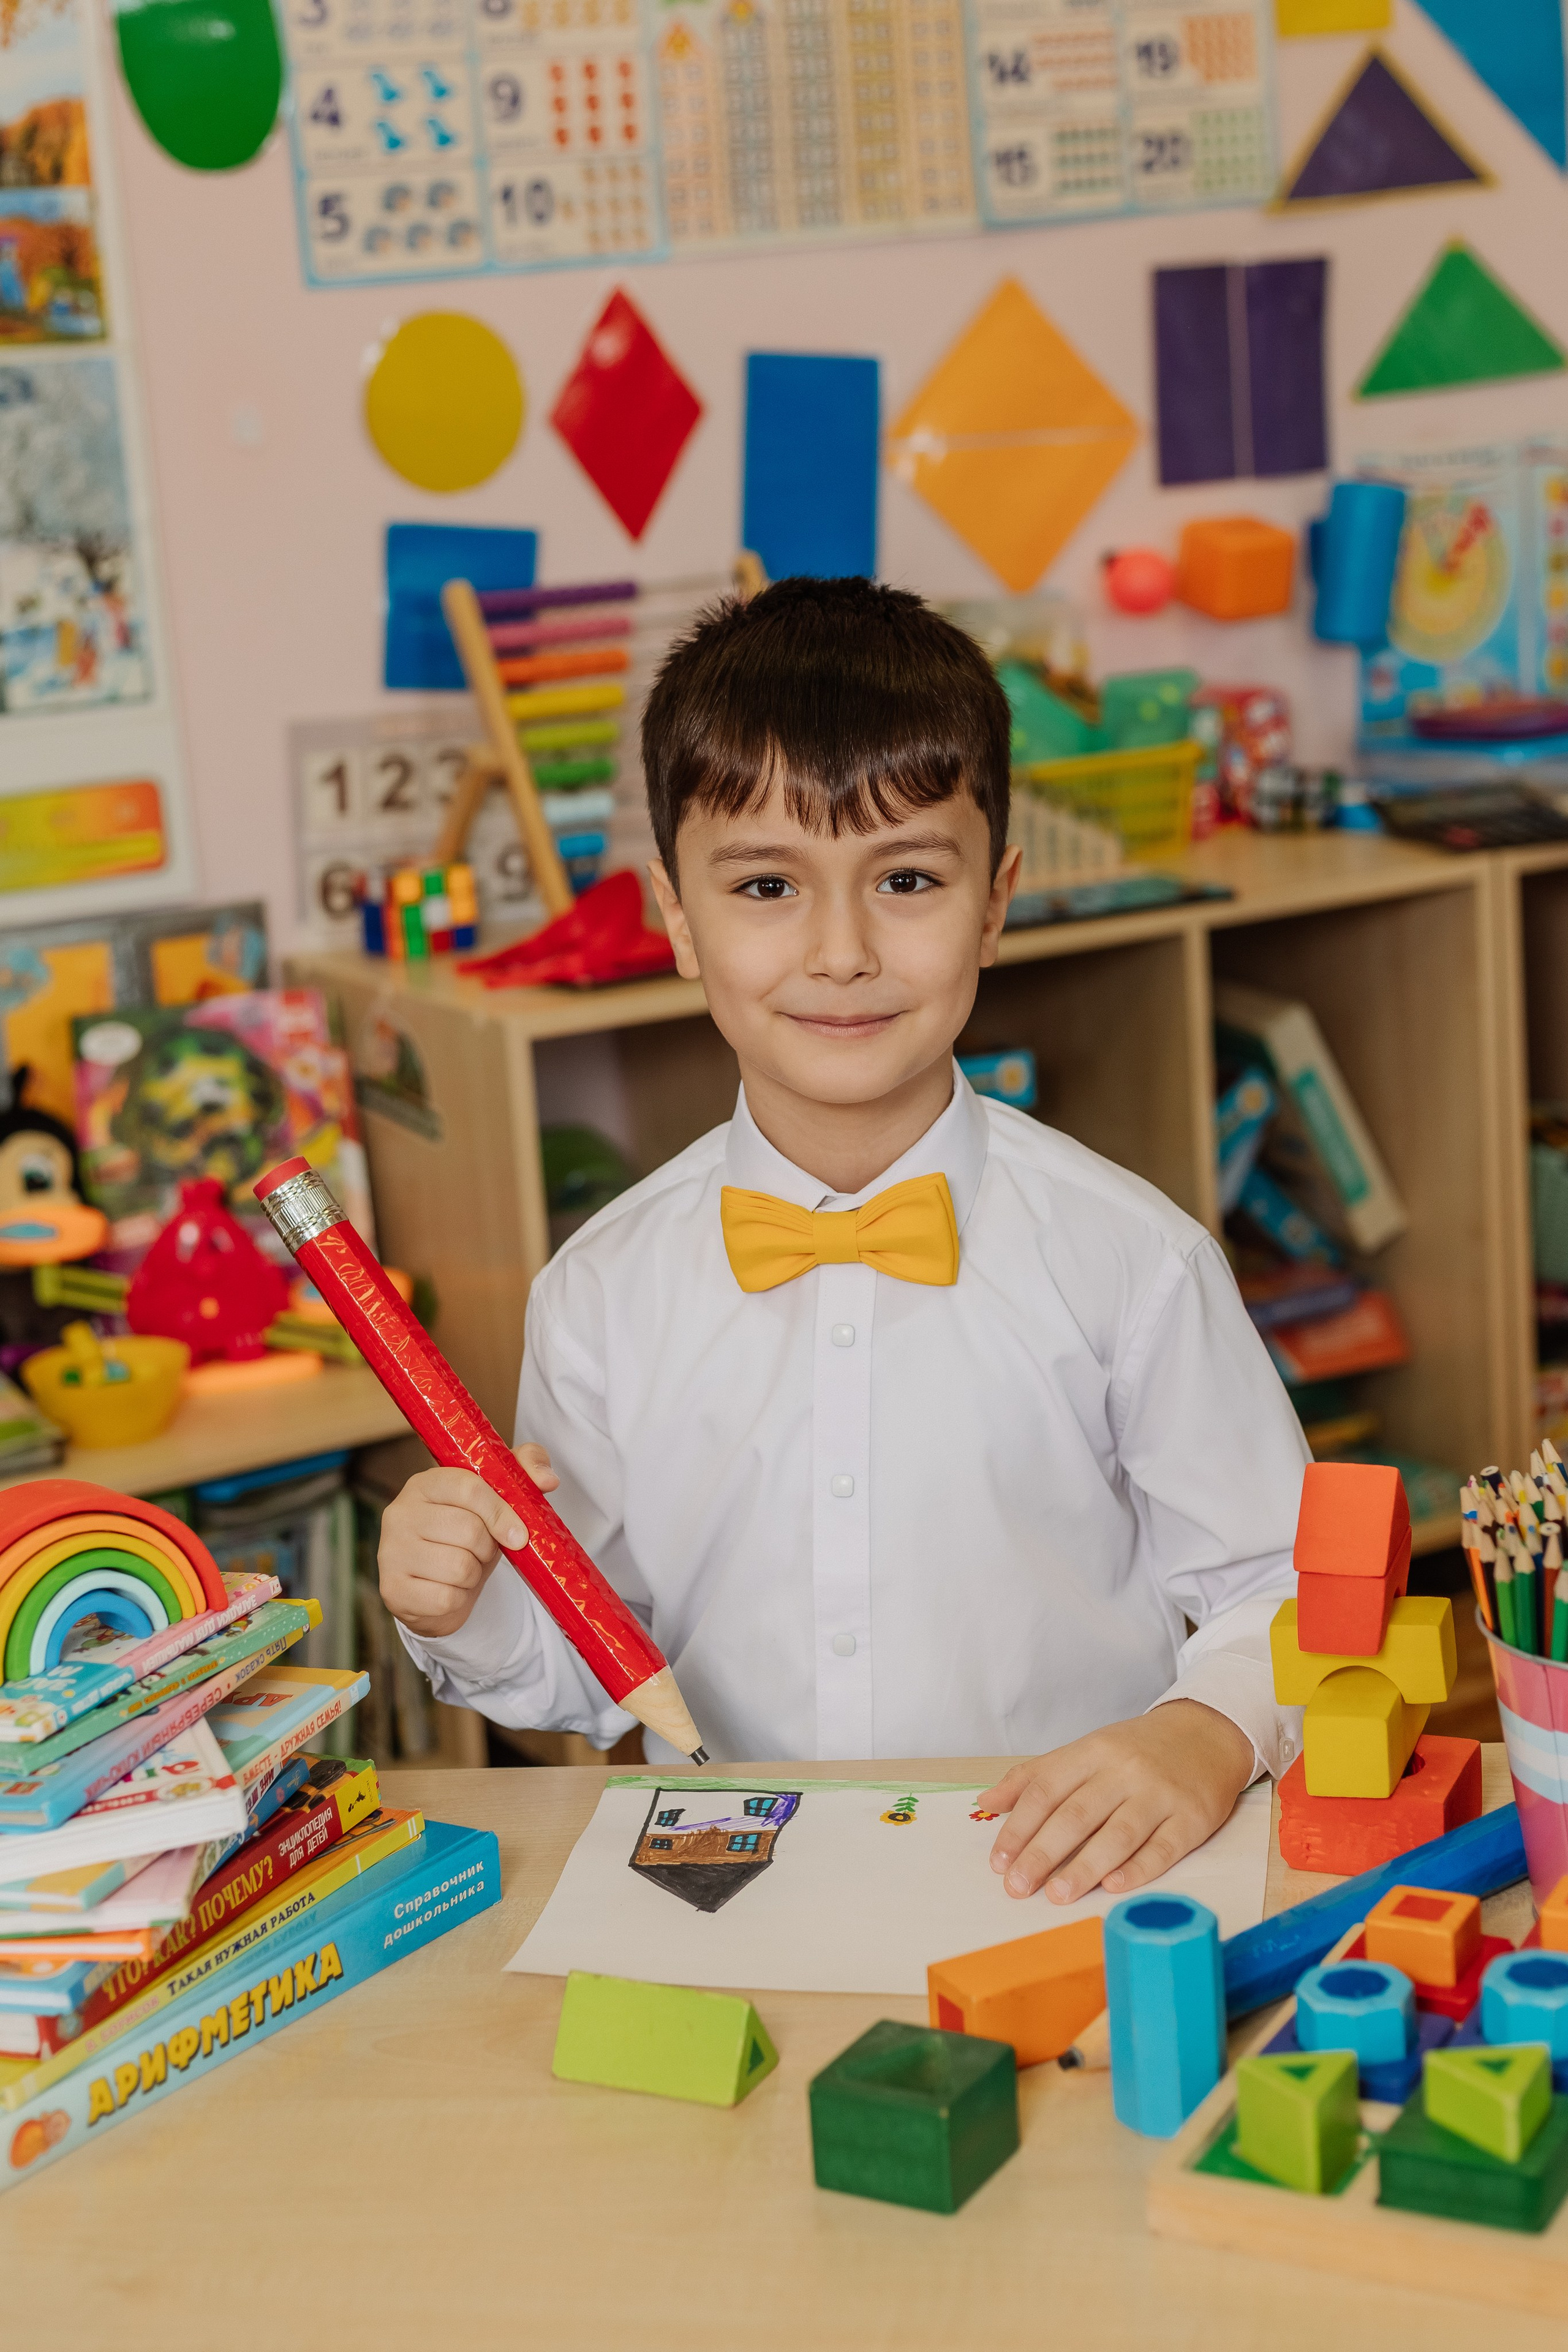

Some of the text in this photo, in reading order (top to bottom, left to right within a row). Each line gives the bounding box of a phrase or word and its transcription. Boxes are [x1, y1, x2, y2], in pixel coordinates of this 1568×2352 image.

[985, 48, 1032, 87] 14
[1134, 37, 1179, 81] 19
[310, 86, 341, 127] 4
[490, 72, 522, 123] 9
[990, 145, 1040, 187] 15
[1136, 130, 1193, 175] 20
[318, 192, 350, 241] 5
[500, 180, 554, 228] 10
[320, 757, 350, 816] 1
[377, 751, 418, 812] 2
[317, 844, 535, 920] 6 9
[141, 1594, 257, 1673] ЗАГАДКИ ДЛЯ МАЛЫШЕЙ
[143, 1687, 222, 1758] СЕРЕБРЯНЫЙ
[243, 1754, 273, 1785] ВМЕСТЕ
[280, 1723, 315, 1758] ДРУЖНАЯ
[316, 1700, 342, 1732] СЕМЬЯ!
[278, 1806, 333, 1857] ЭНЦИКЛОПЕДИЯ
[288, 1826, 329, 1869] ДЛЯ ДЕТЕЙ
[197, 1855, 274, 1932] ПОЧЕМУ?
[383, 1880, 485, 1950] дошкольника
[394, 1860, 484, 1919] Справочник
[214, 1923, 268, 1967] НУЖНАЯ
[270, 1891, 316, 1930] РАБОТА
[87, 1941, 344, 2128] АРИФМЕТИКА
